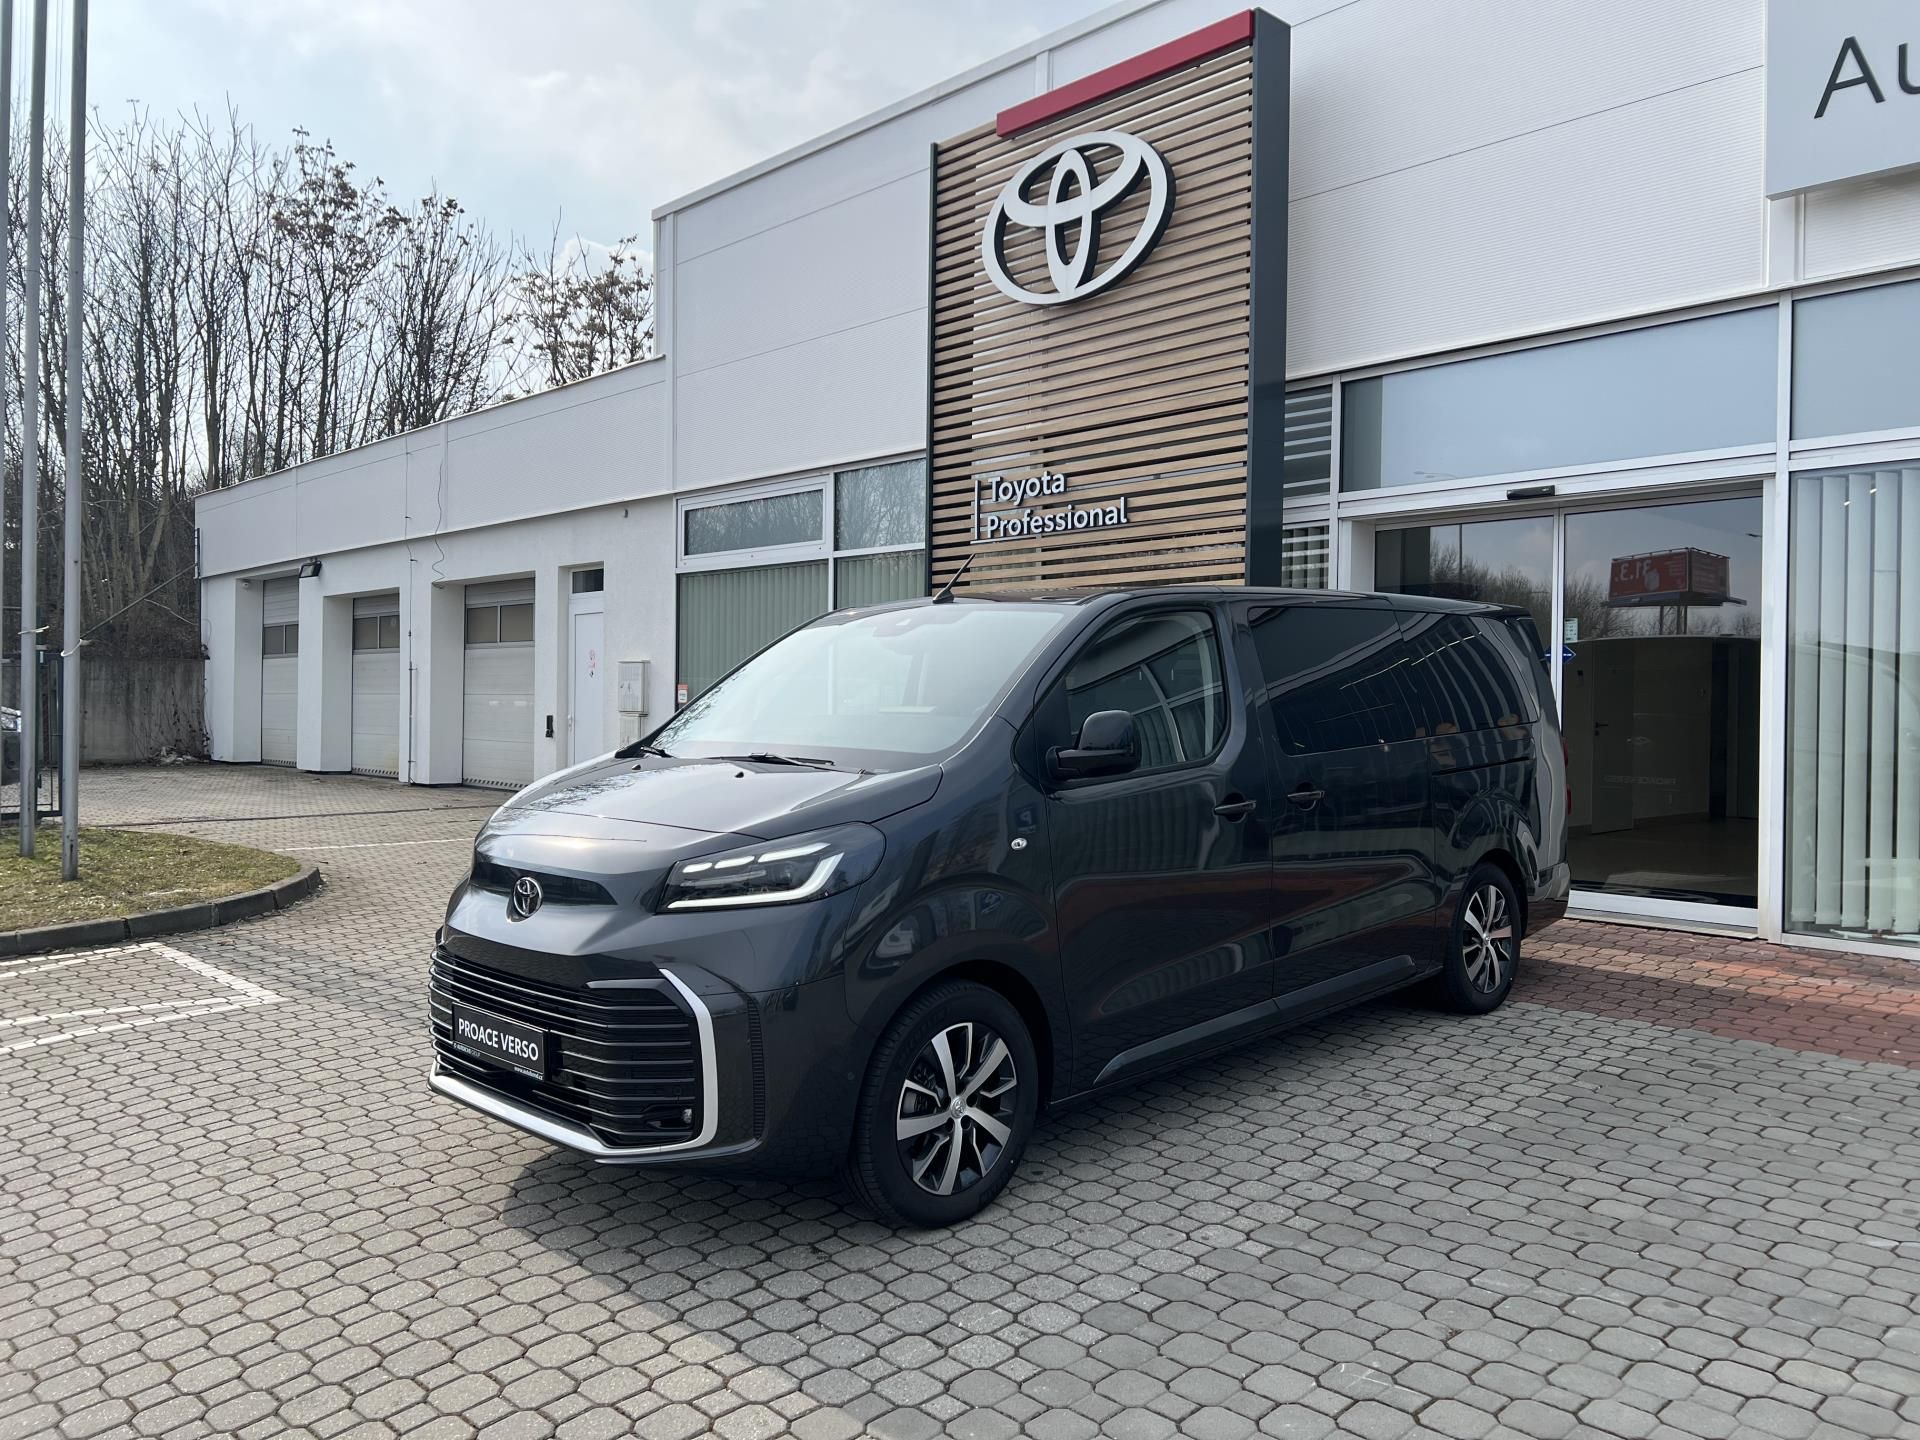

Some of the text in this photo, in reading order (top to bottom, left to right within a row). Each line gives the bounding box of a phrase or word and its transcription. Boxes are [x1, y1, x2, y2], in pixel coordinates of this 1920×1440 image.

[988, 470, 1066, 506] Toyota
[987, 496, 1128, 539] Professional
[458, 1017, 499, 1048] PROACE
[500, 1032, 539, 1061] VERSO
